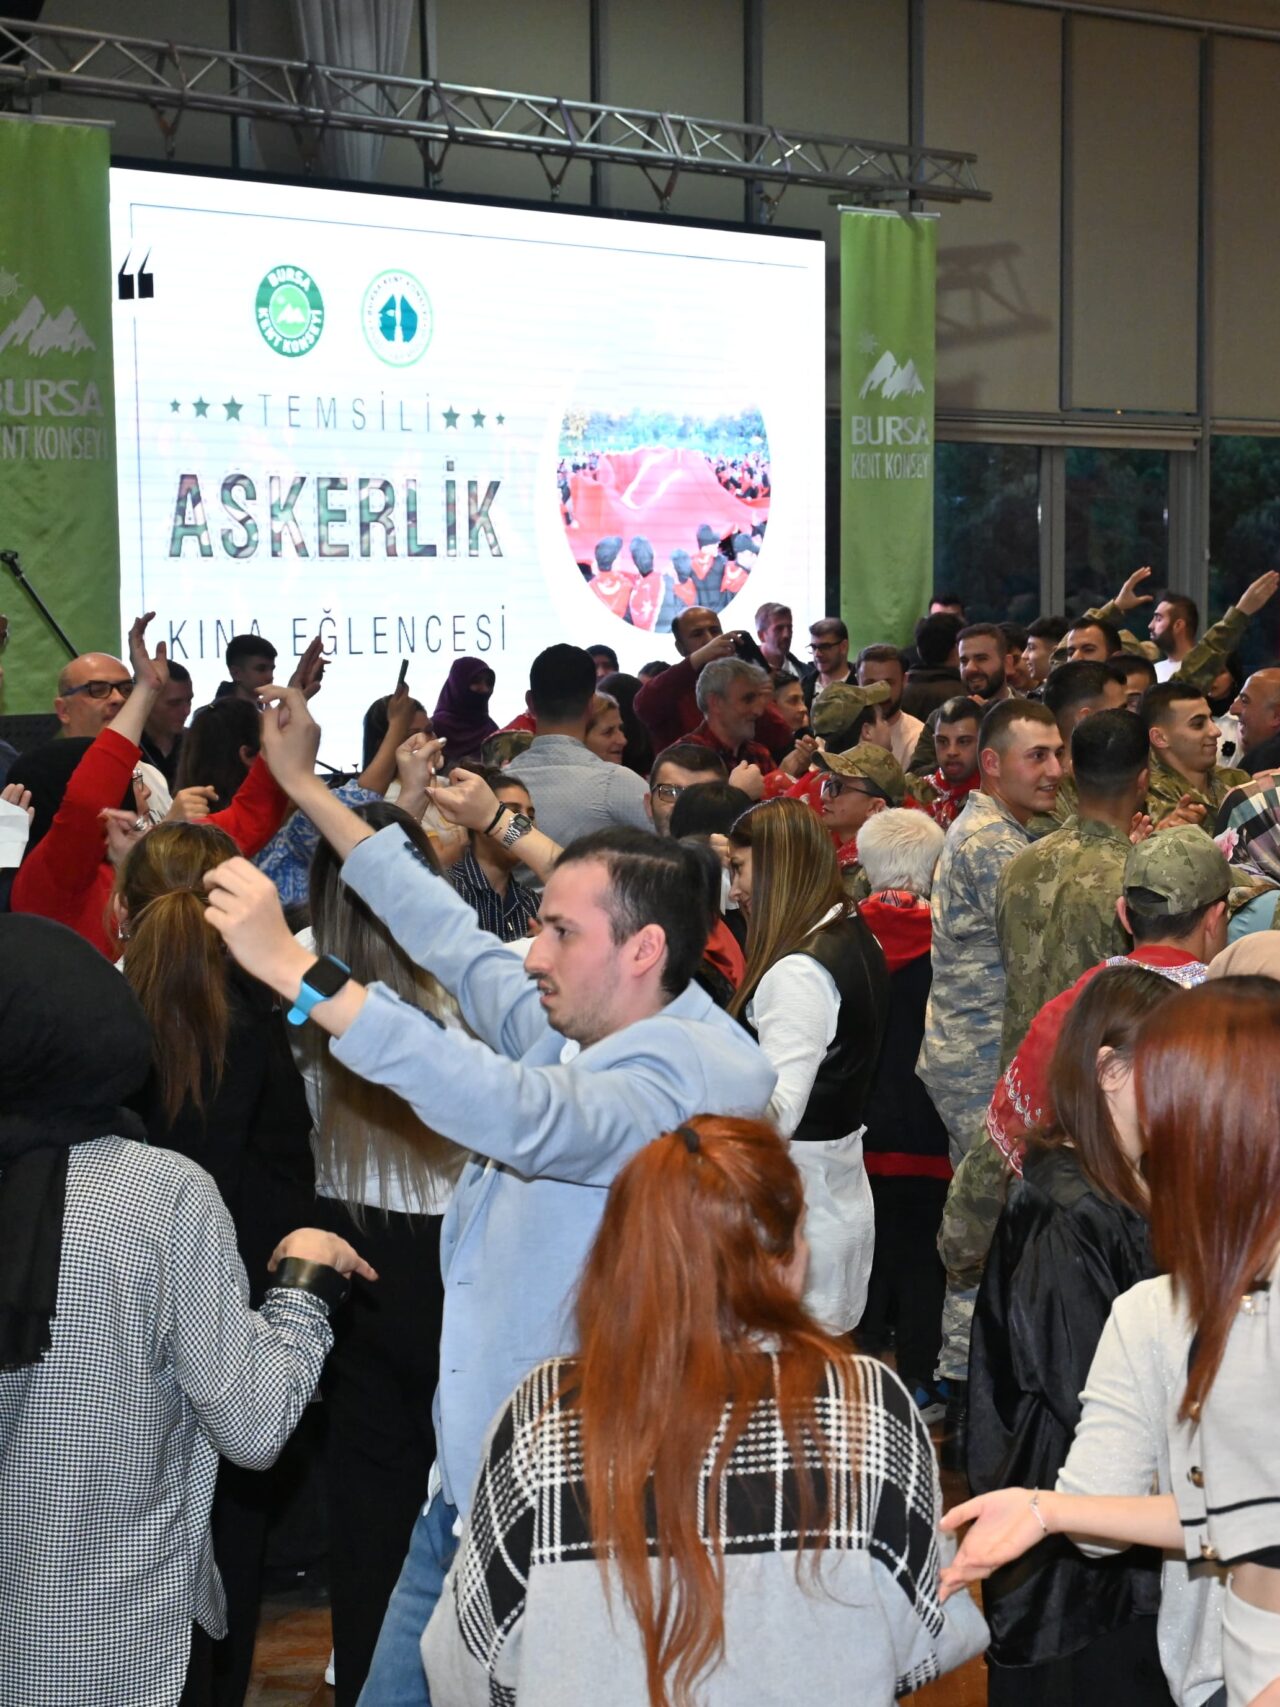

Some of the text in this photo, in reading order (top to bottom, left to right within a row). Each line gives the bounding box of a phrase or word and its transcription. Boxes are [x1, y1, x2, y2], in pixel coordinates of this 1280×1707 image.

[267, 267, 311, 291] BURSA
[0, 379, 104, 416] URSA
[258, 391, 432, 431] TEMSİLİ
[3, 426, 28, 459] NT
[851, 416, 930, 445] BURSA
[851, 453, 930, 480] KENT KONSEY
[169, 460, 503, 559] ASKERLİK
[293, 605, 505, 657] EĞLENCESİ
